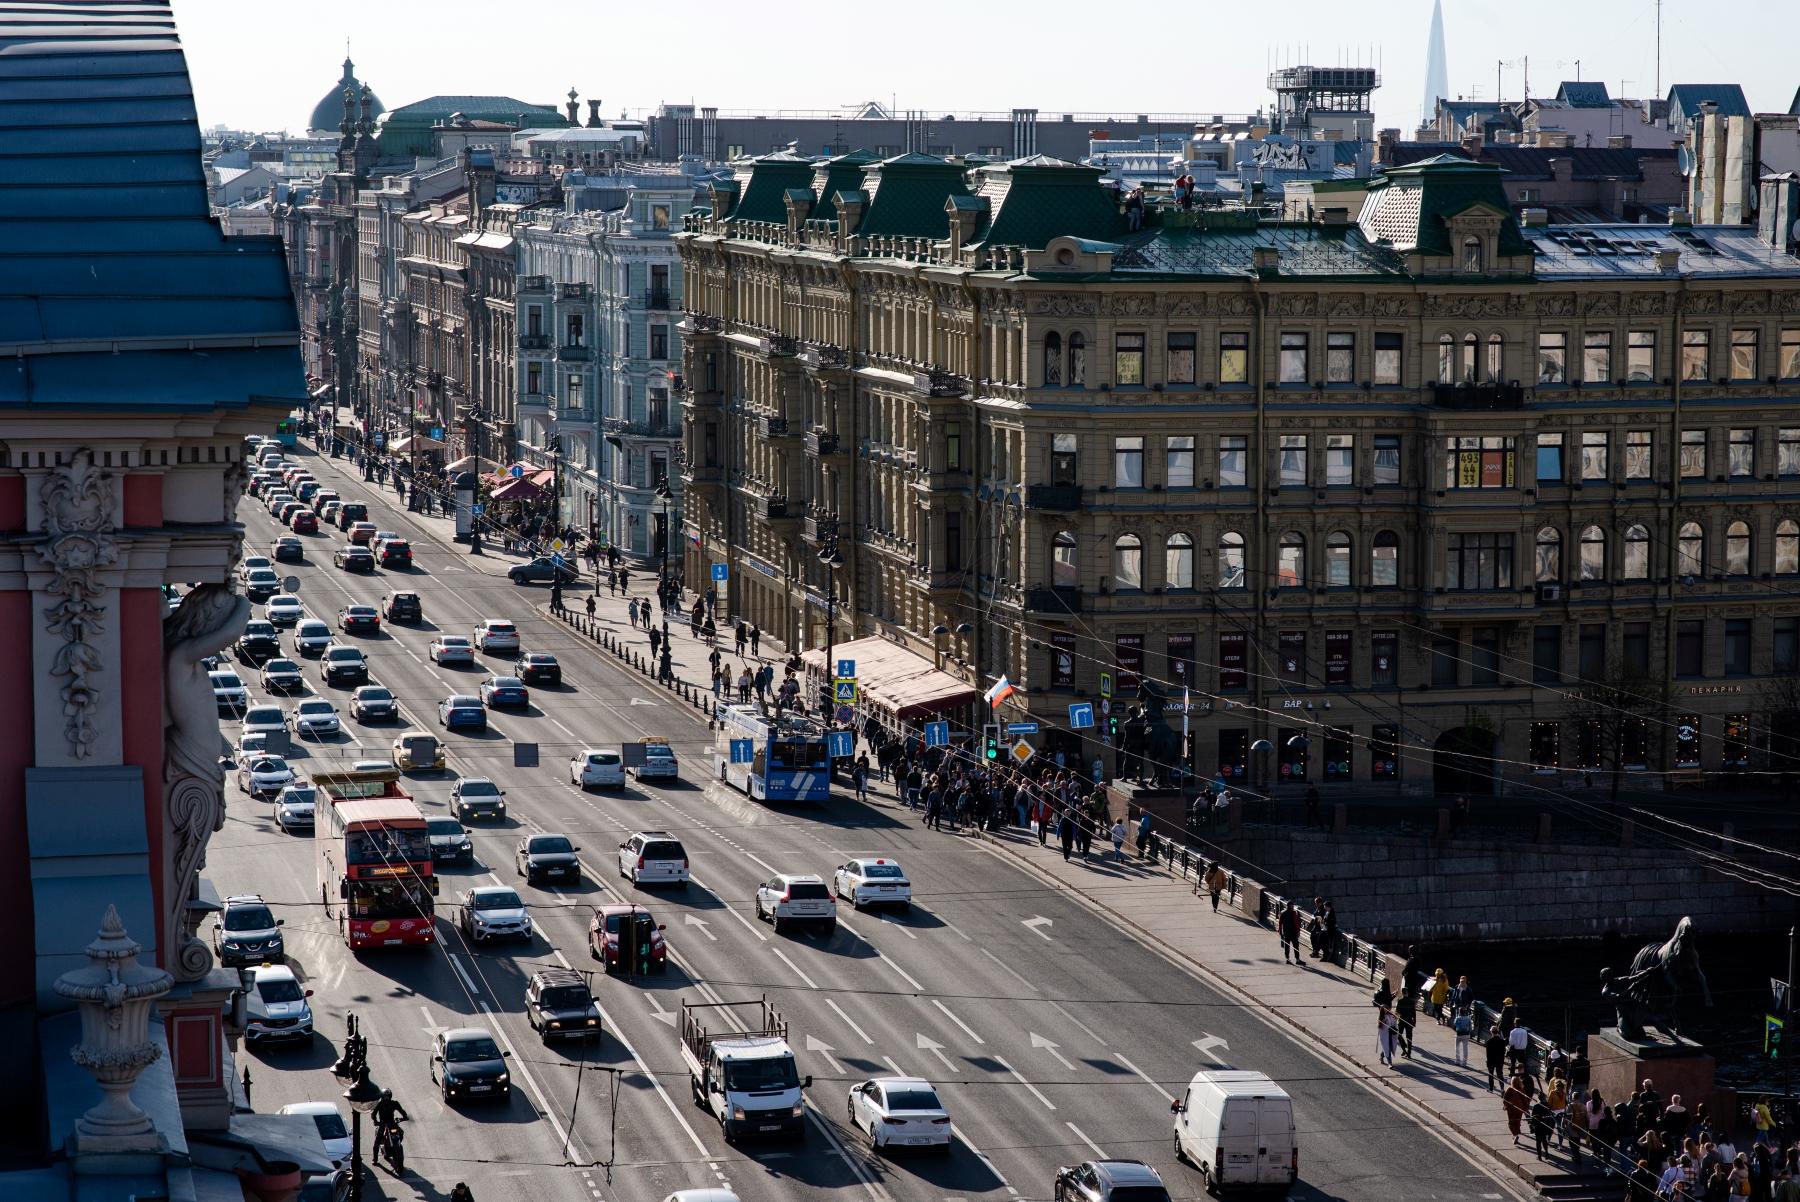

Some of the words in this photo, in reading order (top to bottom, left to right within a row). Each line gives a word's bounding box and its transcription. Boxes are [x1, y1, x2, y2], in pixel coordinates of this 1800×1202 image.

[1461, 453, 1479, 463] 493
[1463, 464, 1476, 473] 44
[1463, 474, 1475, 485] 33
[1691, 686, 1741, 695] ПЕКАРНЯ
[1283, 700, 1302, 708] БАР
